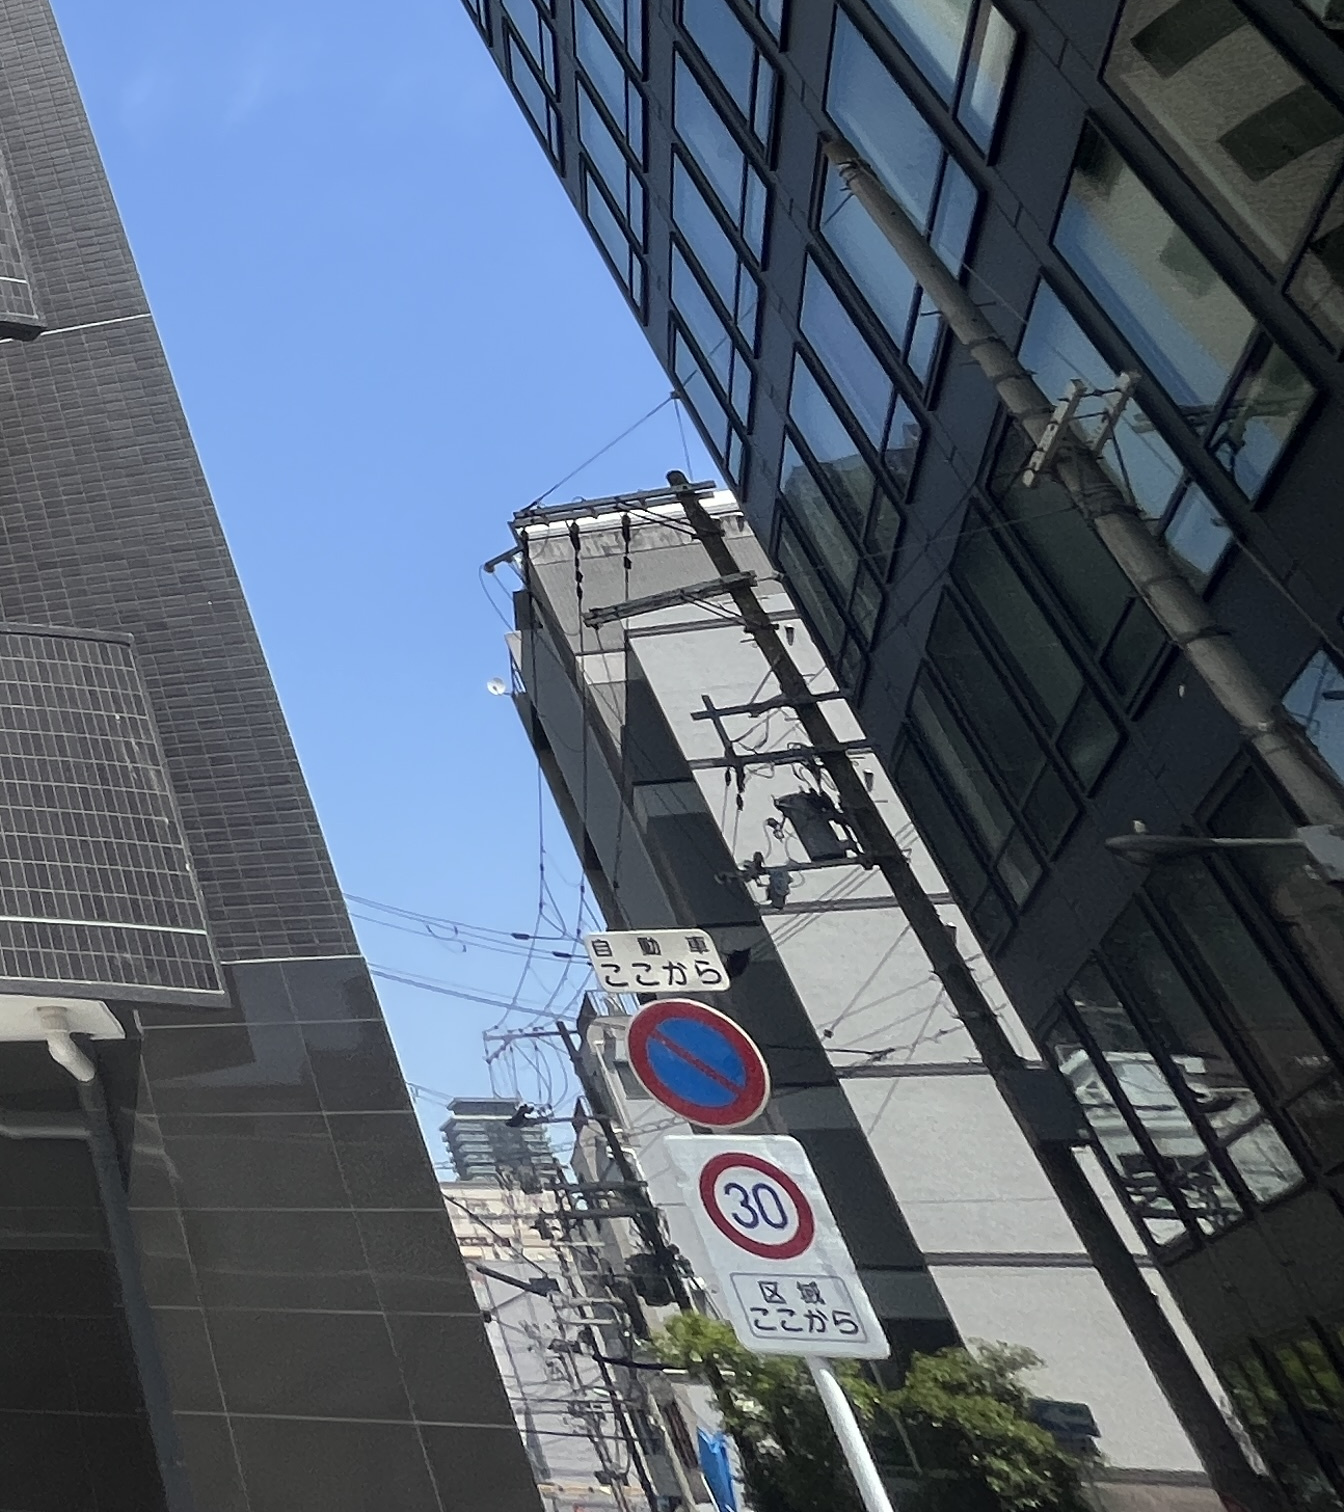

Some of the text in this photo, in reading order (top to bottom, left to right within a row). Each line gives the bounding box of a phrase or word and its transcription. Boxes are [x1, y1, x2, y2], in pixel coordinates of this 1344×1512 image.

[591, 935, 712, 958] 自動車
[600, 960, 723, 988] ここから
[723, 1181, 790, 1230] 30
[757, 1281, 826, 1306] 区域
[749, 1306, 861, 1336] ここから
